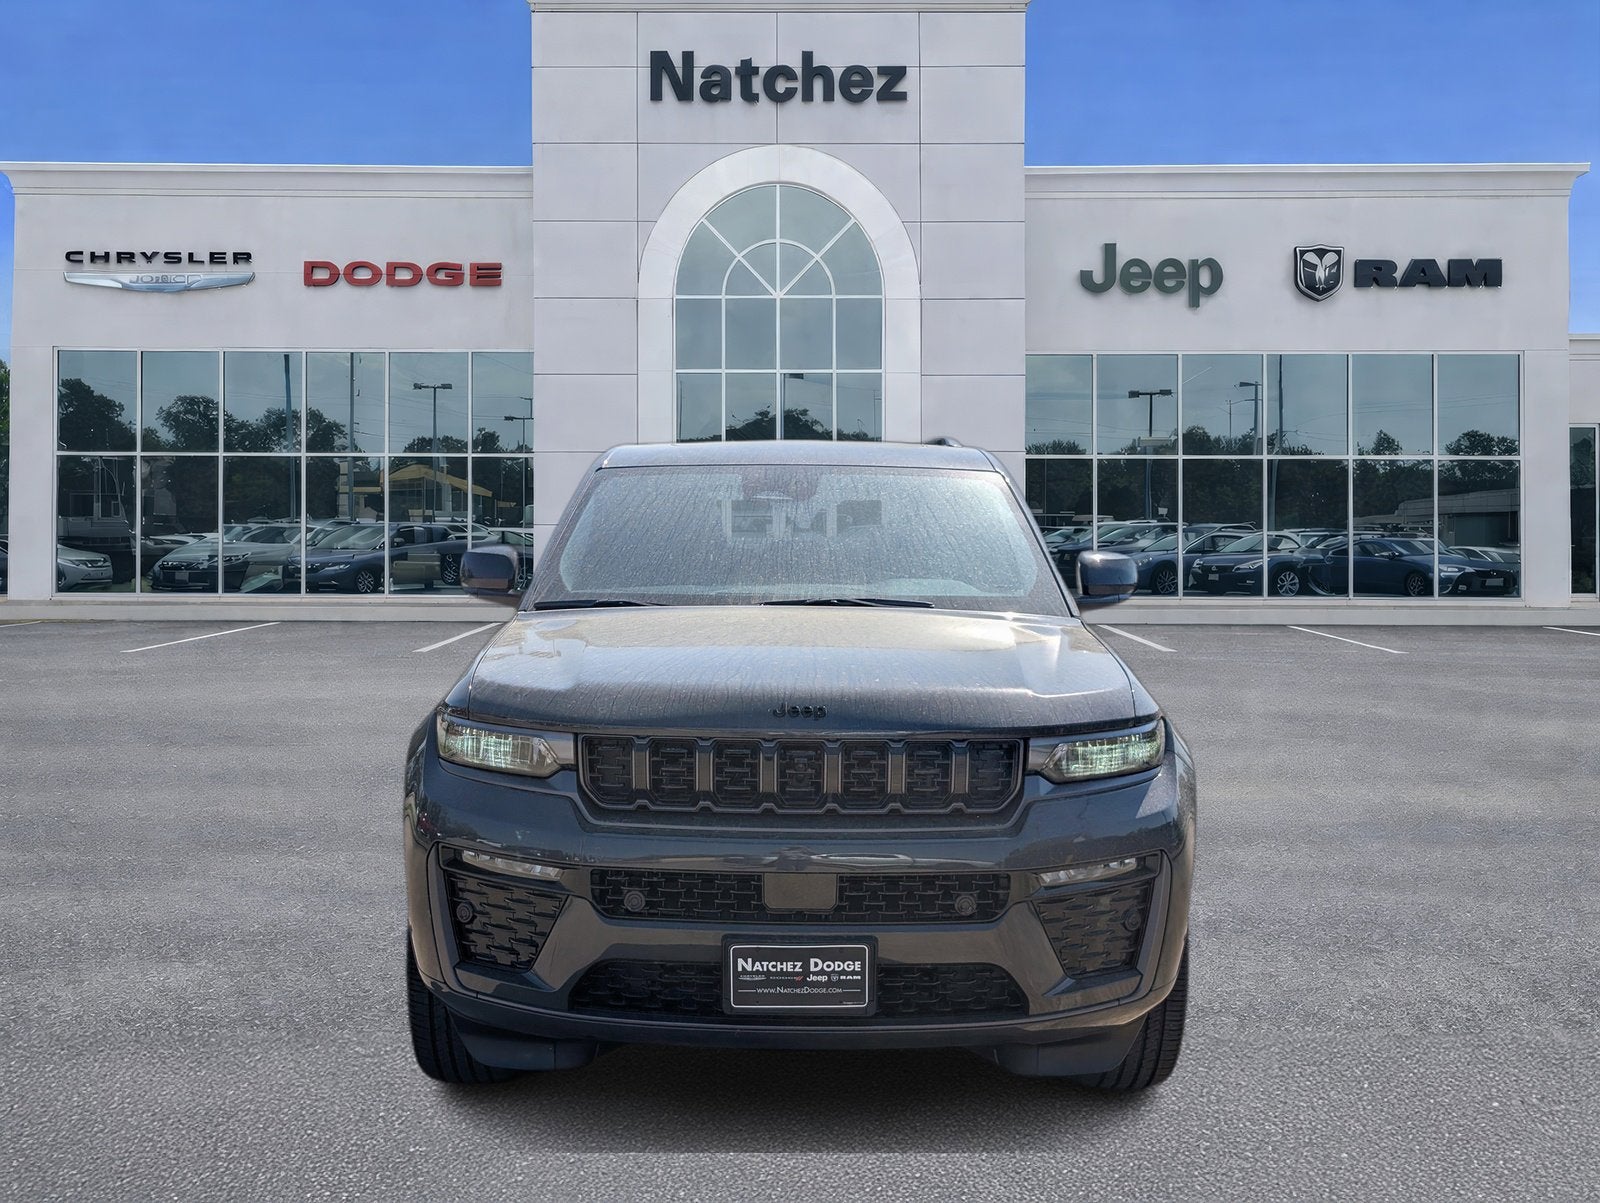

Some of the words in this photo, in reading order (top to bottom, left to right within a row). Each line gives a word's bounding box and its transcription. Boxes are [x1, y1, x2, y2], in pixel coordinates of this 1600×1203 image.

[649, 50, 908, 104] Natchez
[65, 250, 254, 265] CHRYSLER
[303, 260, 503, 288] DODGE
[1079, 242, 1224, 309] Jeep
[1353, 258, 1503, 289] RAM
[770, 702, 827, 721] Jeep
[737, 957, 803, 972] NATCHEZ
[809, 957, 862, 972] DODGE
[806, 973, 828, 983] Jeep
